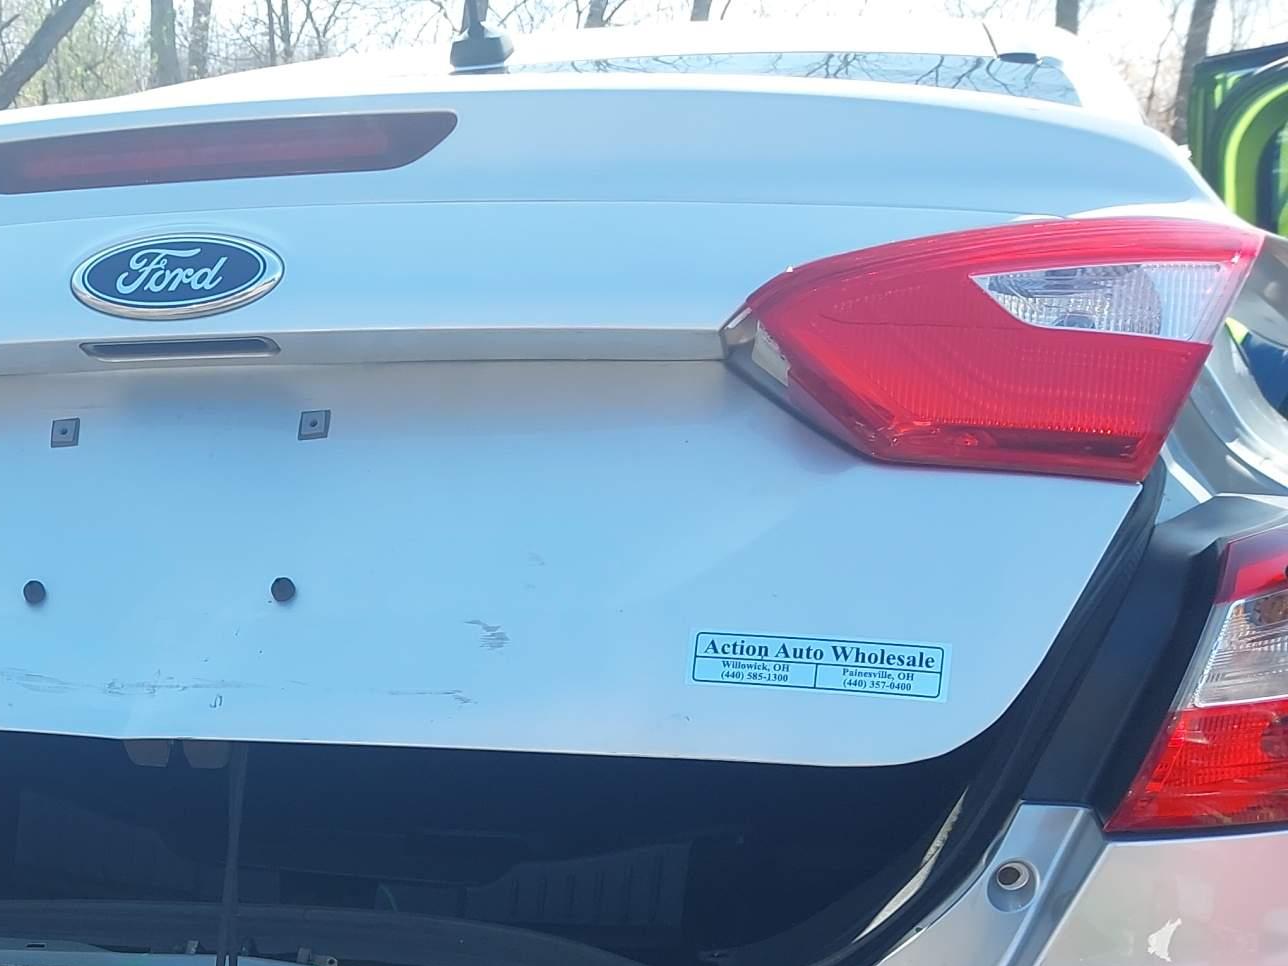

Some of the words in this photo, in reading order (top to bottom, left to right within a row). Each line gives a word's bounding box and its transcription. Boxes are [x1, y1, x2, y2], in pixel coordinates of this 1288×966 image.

[116, 248, 228, 294] Ford
[704, 639, 769, 658] Action
[774, 642, 824, 661] Auto
[831, 645, 935, 669] Wholesale
[722, 660, 770, 672] Willowick,
[773, 663, 790, 673] OH
[721, 670, 745, 681] (440)
[747, 671, 788, 682] 585-1300
[842, 668, 895, 681] Painesville,
[898, 671, 914, 681] OH
[843, 678, 867, 690] (440)
[869, 680, 912, 691] 357-0400
